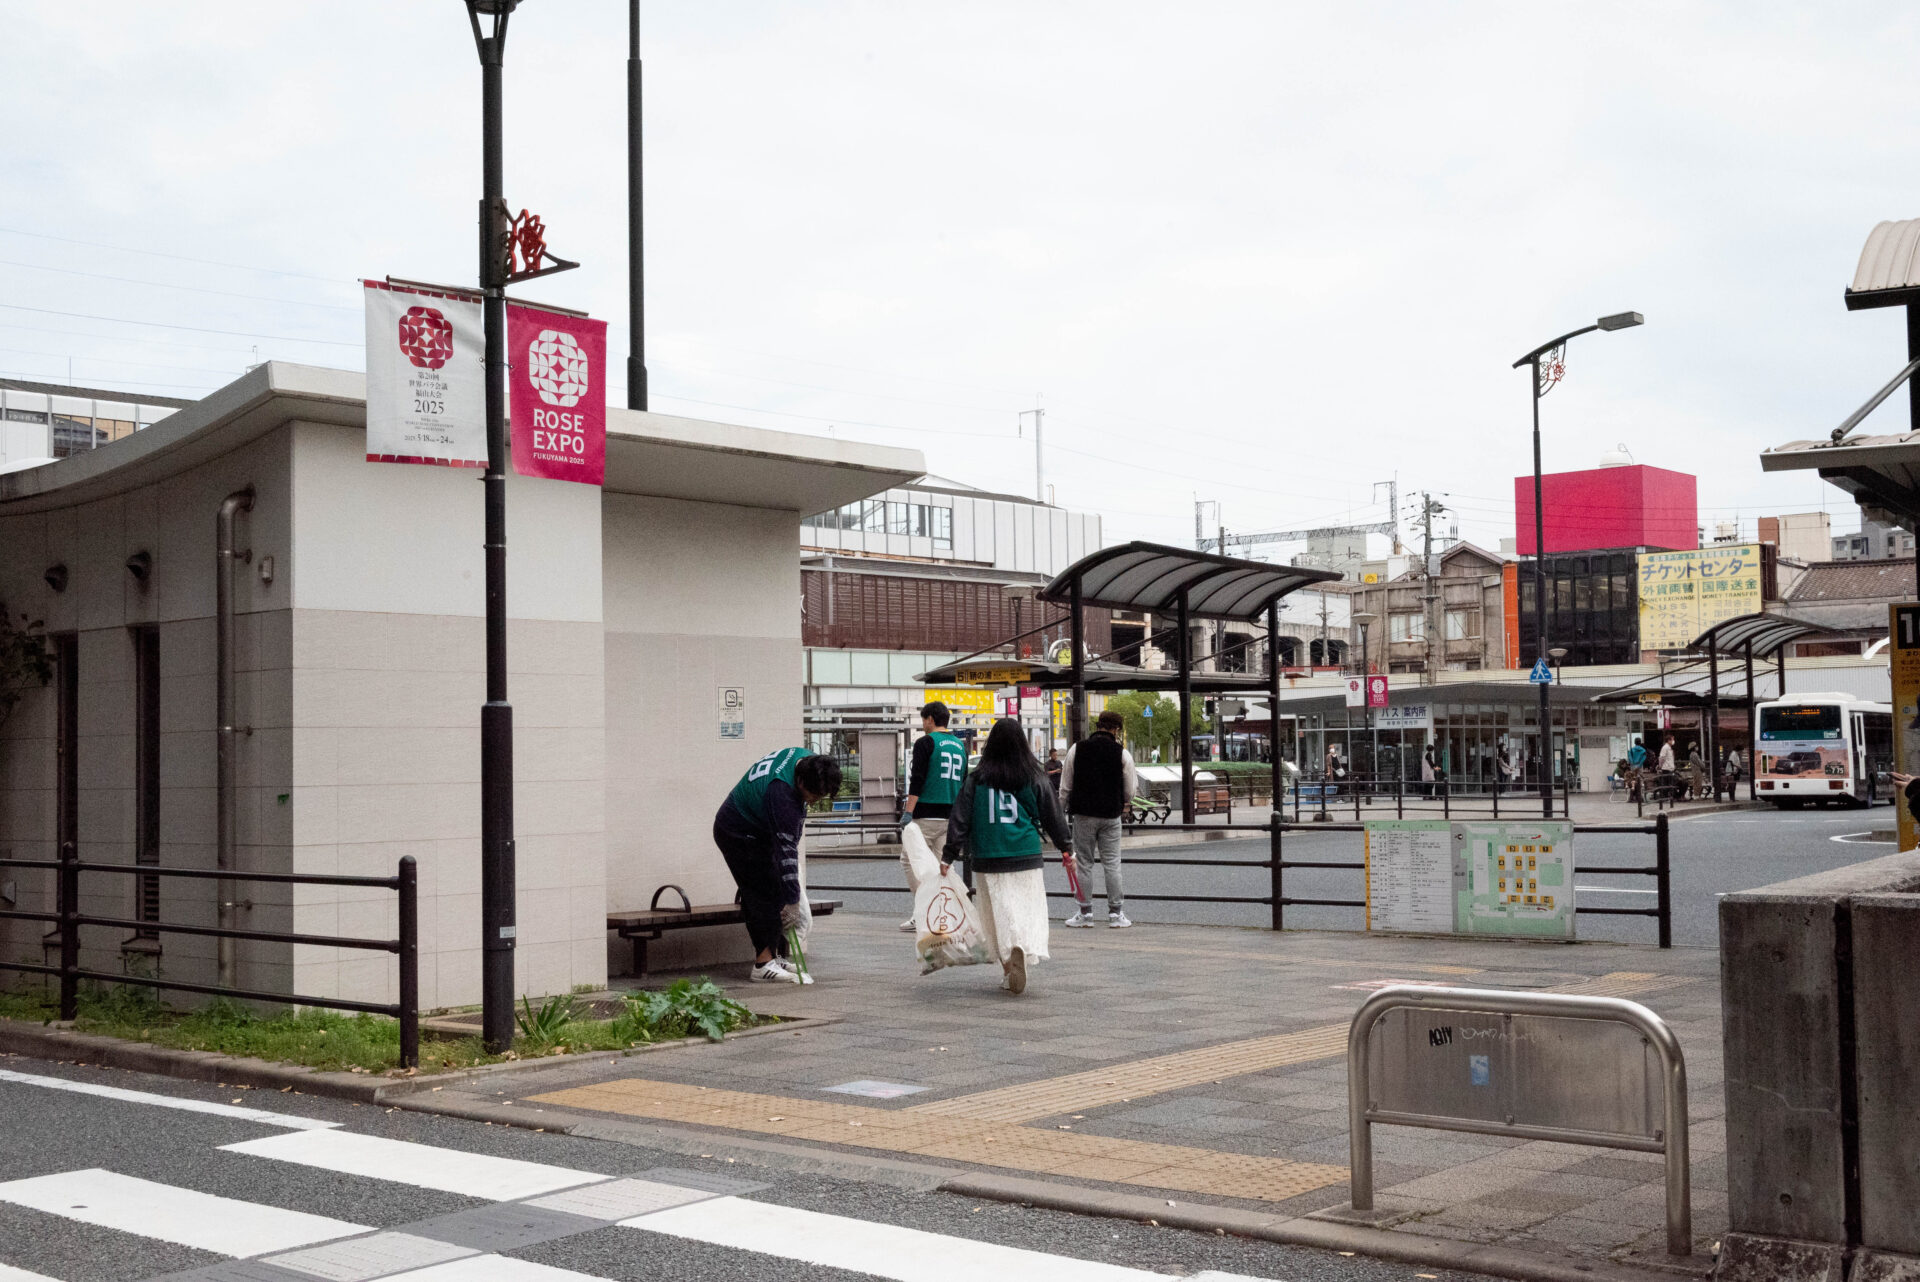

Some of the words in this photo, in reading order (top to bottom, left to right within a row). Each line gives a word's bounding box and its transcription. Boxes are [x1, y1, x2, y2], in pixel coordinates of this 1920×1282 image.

[409, 379, 449, 391] 世界バラ会議
[415, 389, 443, 399] 福山大会
[414, 399, 445, 415] 2025
[533, 408, 585, 434] ROSE
[533, 430, 585, 455] EXPO
[533, 452, 568, 463] FUKUYAMA
[569, 457, 585, 465] 2025
[1641, 558, 1758, 582] チケットセンター
[1643, 582, 1695, 596] 外貨両替
[1702, 578, 1758, 593] 国際送金
[1725, 591, 1758, 599] TRANSFER
[1403, 705, 1427, 718] 案内所
[940, 751, 963, 782] 32
[988, 787, 1019, 824] 19
